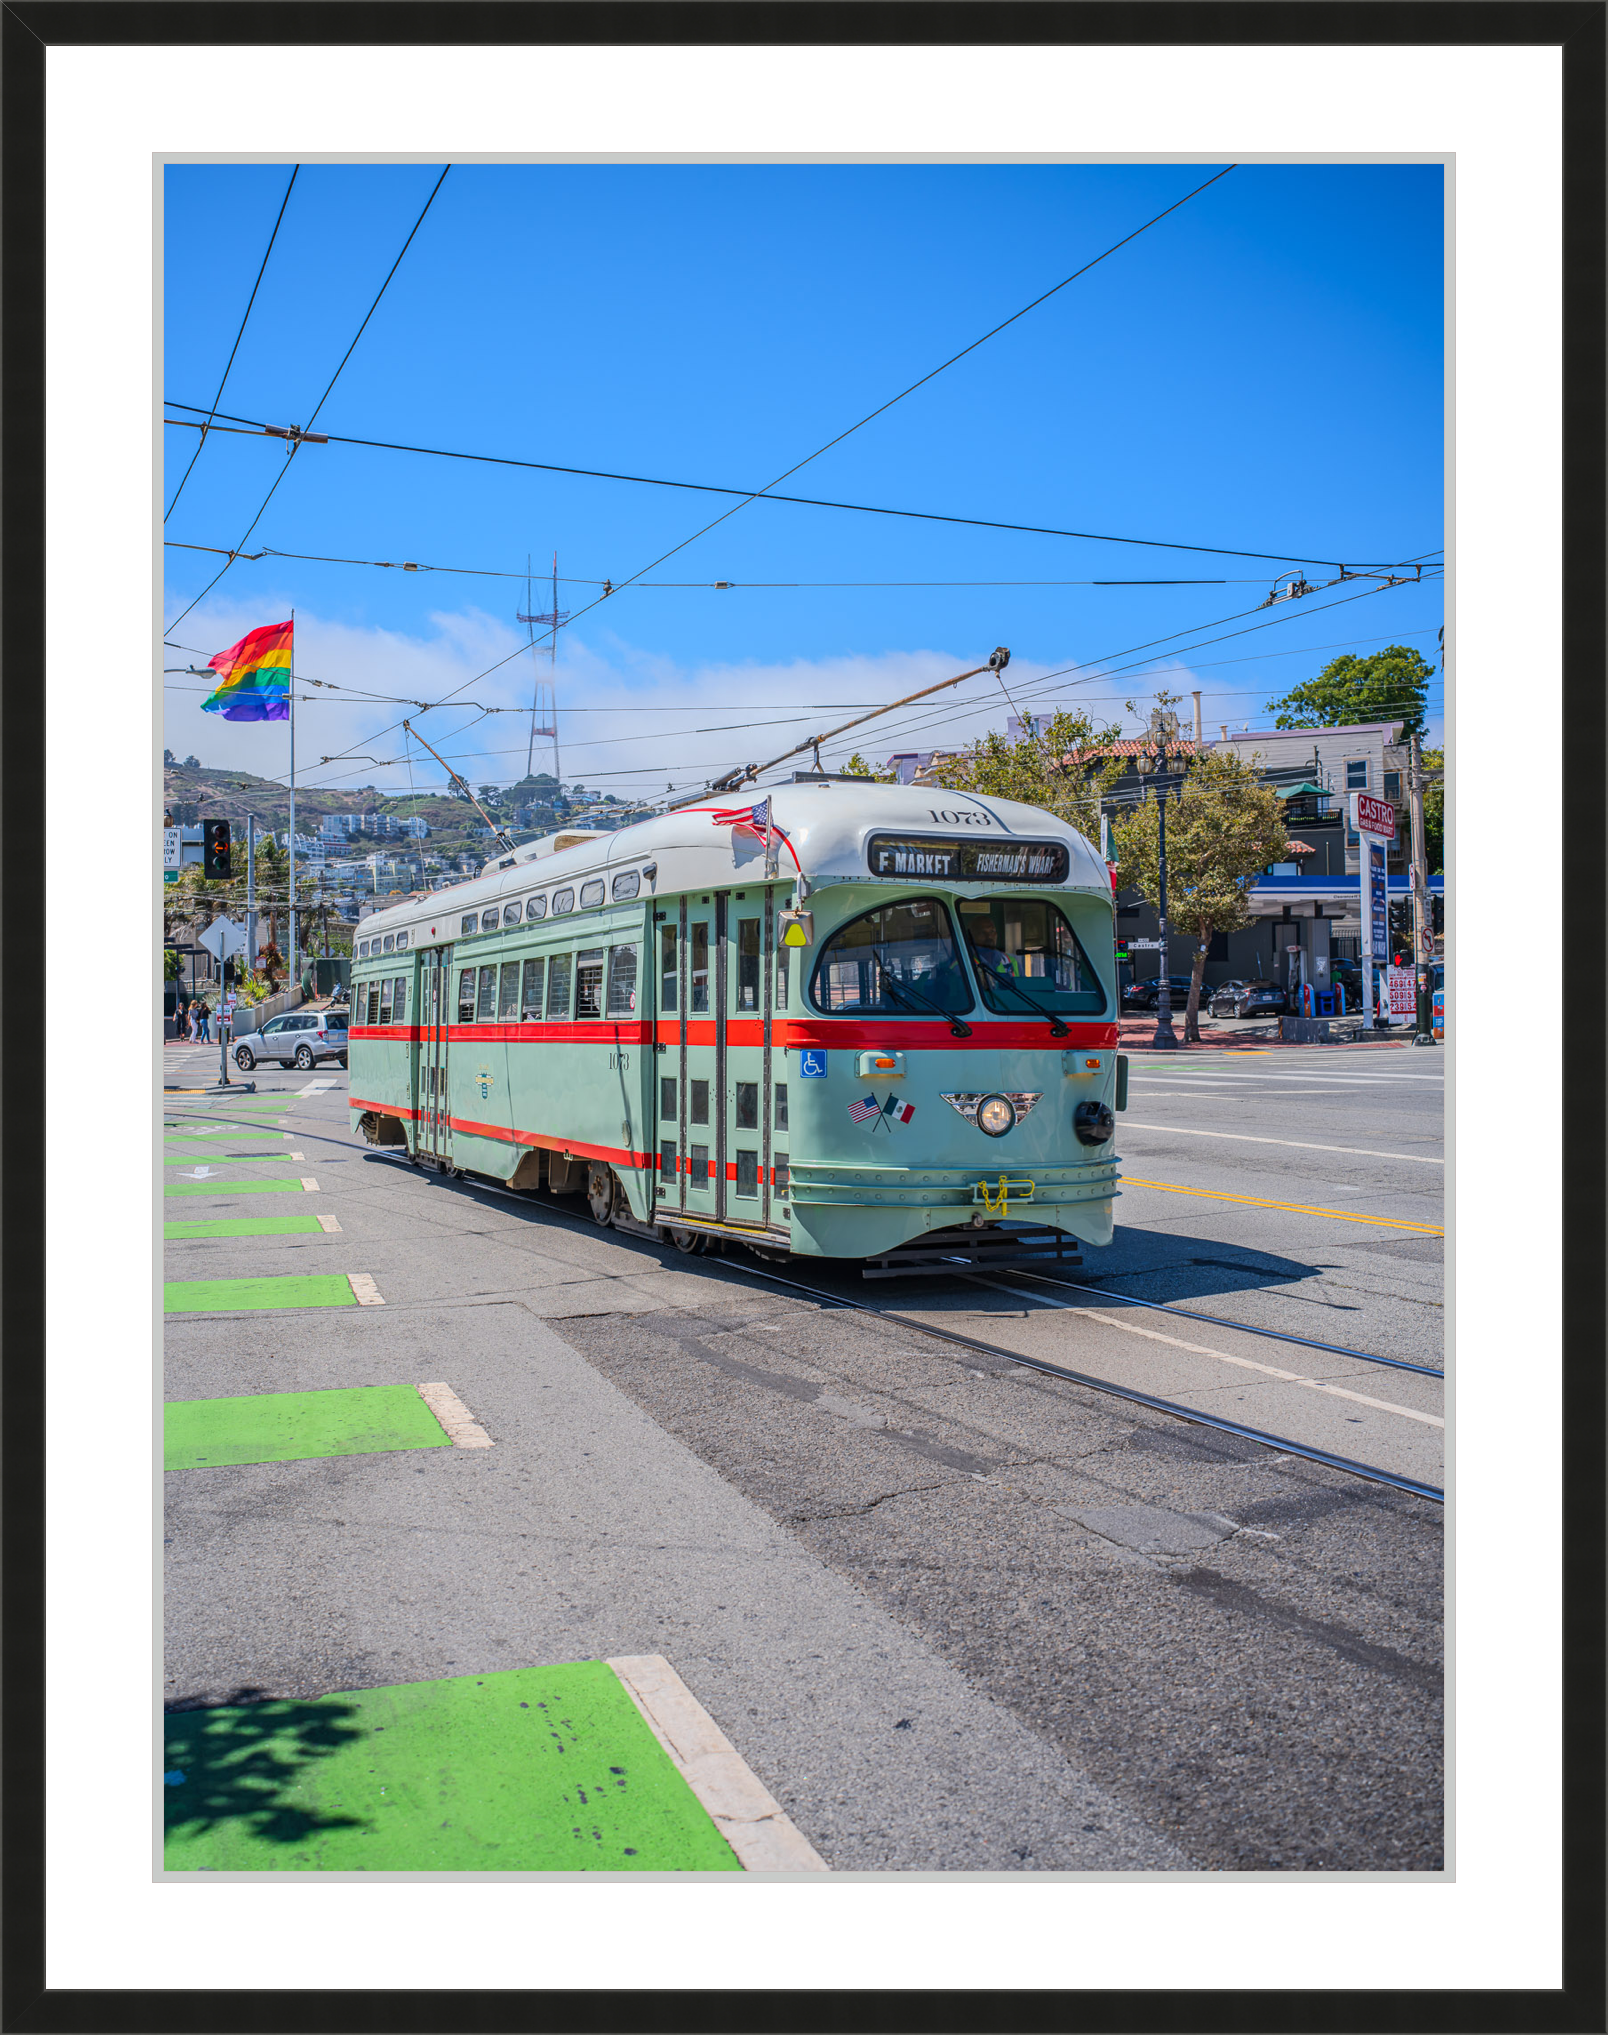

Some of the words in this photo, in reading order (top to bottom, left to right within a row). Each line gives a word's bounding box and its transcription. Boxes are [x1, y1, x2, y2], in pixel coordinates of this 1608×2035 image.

[927, 809, 991, 826] 1073
[1359, 797, 1393, 824] CASTRO
[168, 831, 178, 839] ON
[879, 852, 889, 872] F
[976, 853, 1027, 873] FISHERMAN'S
[1028, 855, 1055, 874] WHARF
